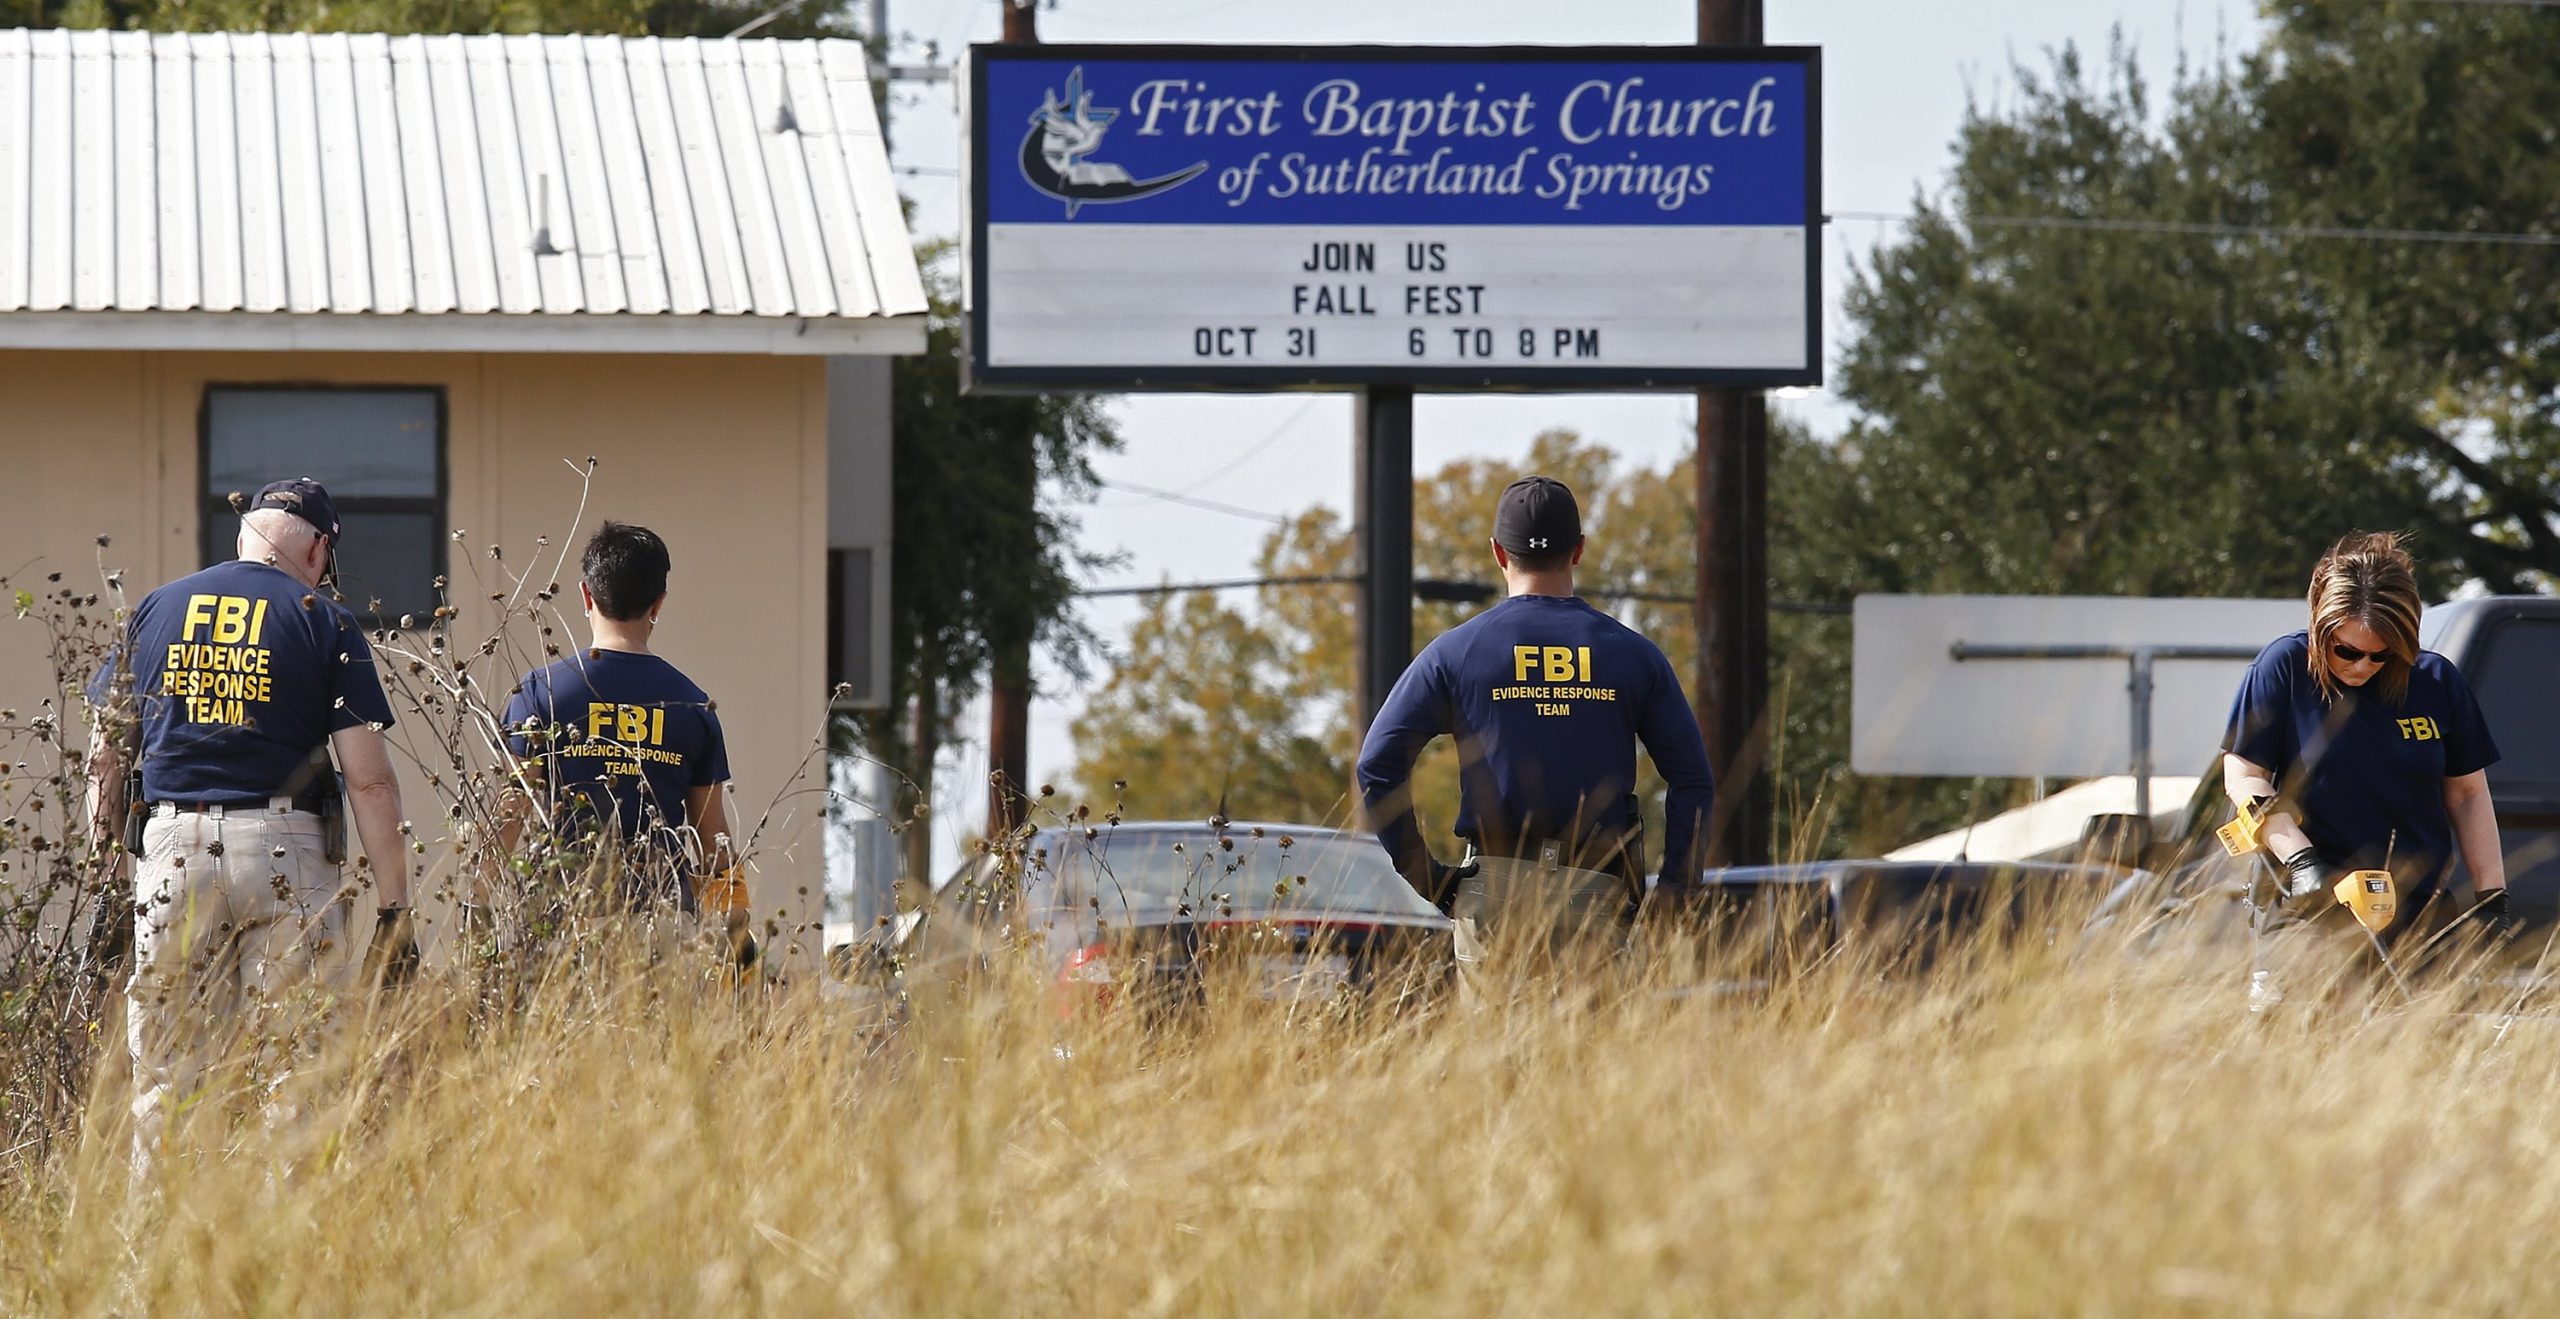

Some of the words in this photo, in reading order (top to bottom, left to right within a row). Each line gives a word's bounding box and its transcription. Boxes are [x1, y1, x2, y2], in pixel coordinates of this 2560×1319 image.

[1130, 78, 1283, 136] First
[1303, 78, 1536, 156] Baptist
[1559, 76, 1776, 145] Church
[1218, 151, 1271, 207] of
[1268, 147, 1538, 198] Sutherland
[1535, 151, 1714, 211] Springs
[1303, 242, 1376, 273] JOIN
[1406, 242, 1447, 273] US
[1293, 285, 1377, 315] FALL
[1405, 285, 1486, 315] FEST
[1194, 327, 1258, 357] OCT
[1287, 327, 1316, 358] 31
[1407, 328, 1426, 357] 6
[1453, 328, 1493, 357] TO
[1518, 328, 1536, 357] 8
[1554, 328, 1600, 358] PM
[182, 593, 269, 646] FBI
[167, 643, 271, 675] EVIDENCE
[1513, 645, 1592, 682] FBI
[162, 670, 272, 702] RESPONSE
[1492, 686, 1550, 700] EVIDENCE
[1553, 686, 1616, 701] RESPONSE
[185, 696, 244, 726] TEAM
[588, 702, 665, 746] FBI
[1535, 703, 1571, 716] TEAM
[2394, 716, 2441, 741] FBI
[563, 743, 622, 759] EVIDENCE
[604, 761, 641, 776] TEAM
